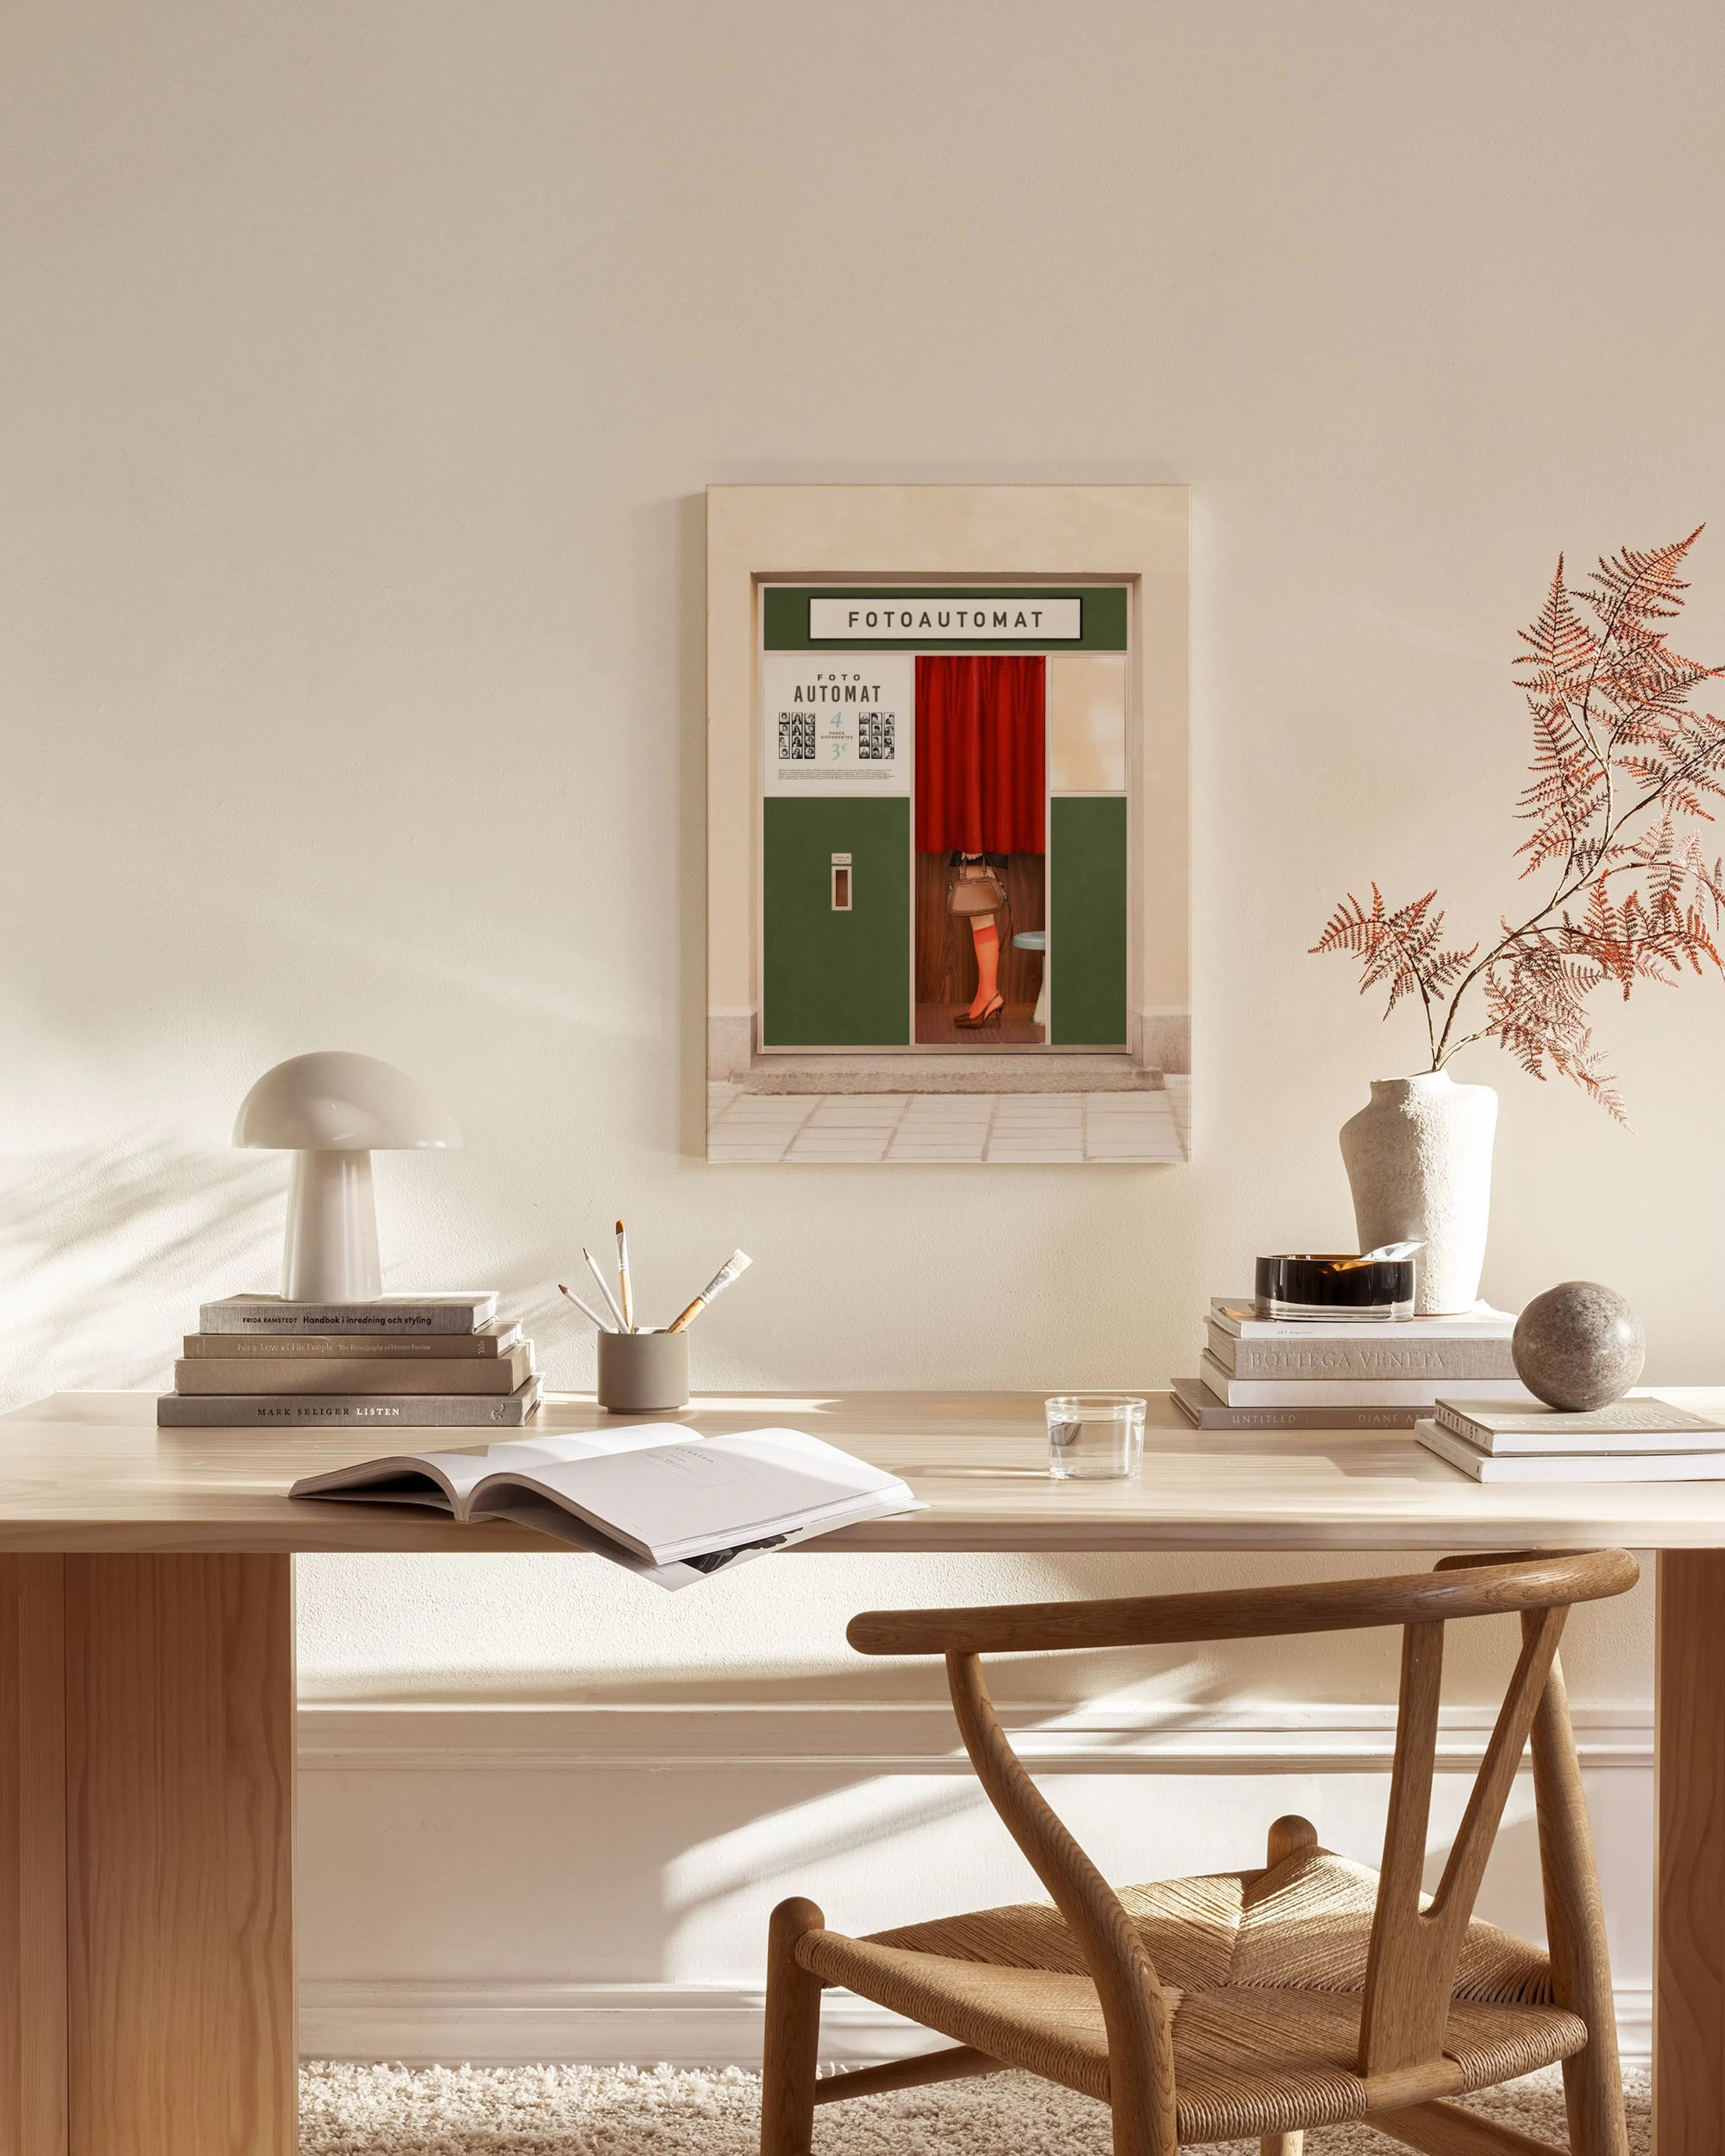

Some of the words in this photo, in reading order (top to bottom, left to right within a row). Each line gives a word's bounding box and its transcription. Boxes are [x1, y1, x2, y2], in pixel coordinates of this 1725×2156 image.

[849, 611, 1042, 627] FOTOAUTOMAT
[794, 685, 880, 702] AUTOMAT
[830, 711, 842, 729] 4
[346, 1316, 385, 1325] inredning
[404, 1316, 432, 1325] styling
[307, 1343, 334, 1352] People
[1250, 1352, 1351, 1368] BOTTEGA
[1359, 1352, 1445, 1368] VENETA
[1233, 1415, 1296, 1423] UNTITLED
[1359, 1414, 1398, 1423] DIANE
